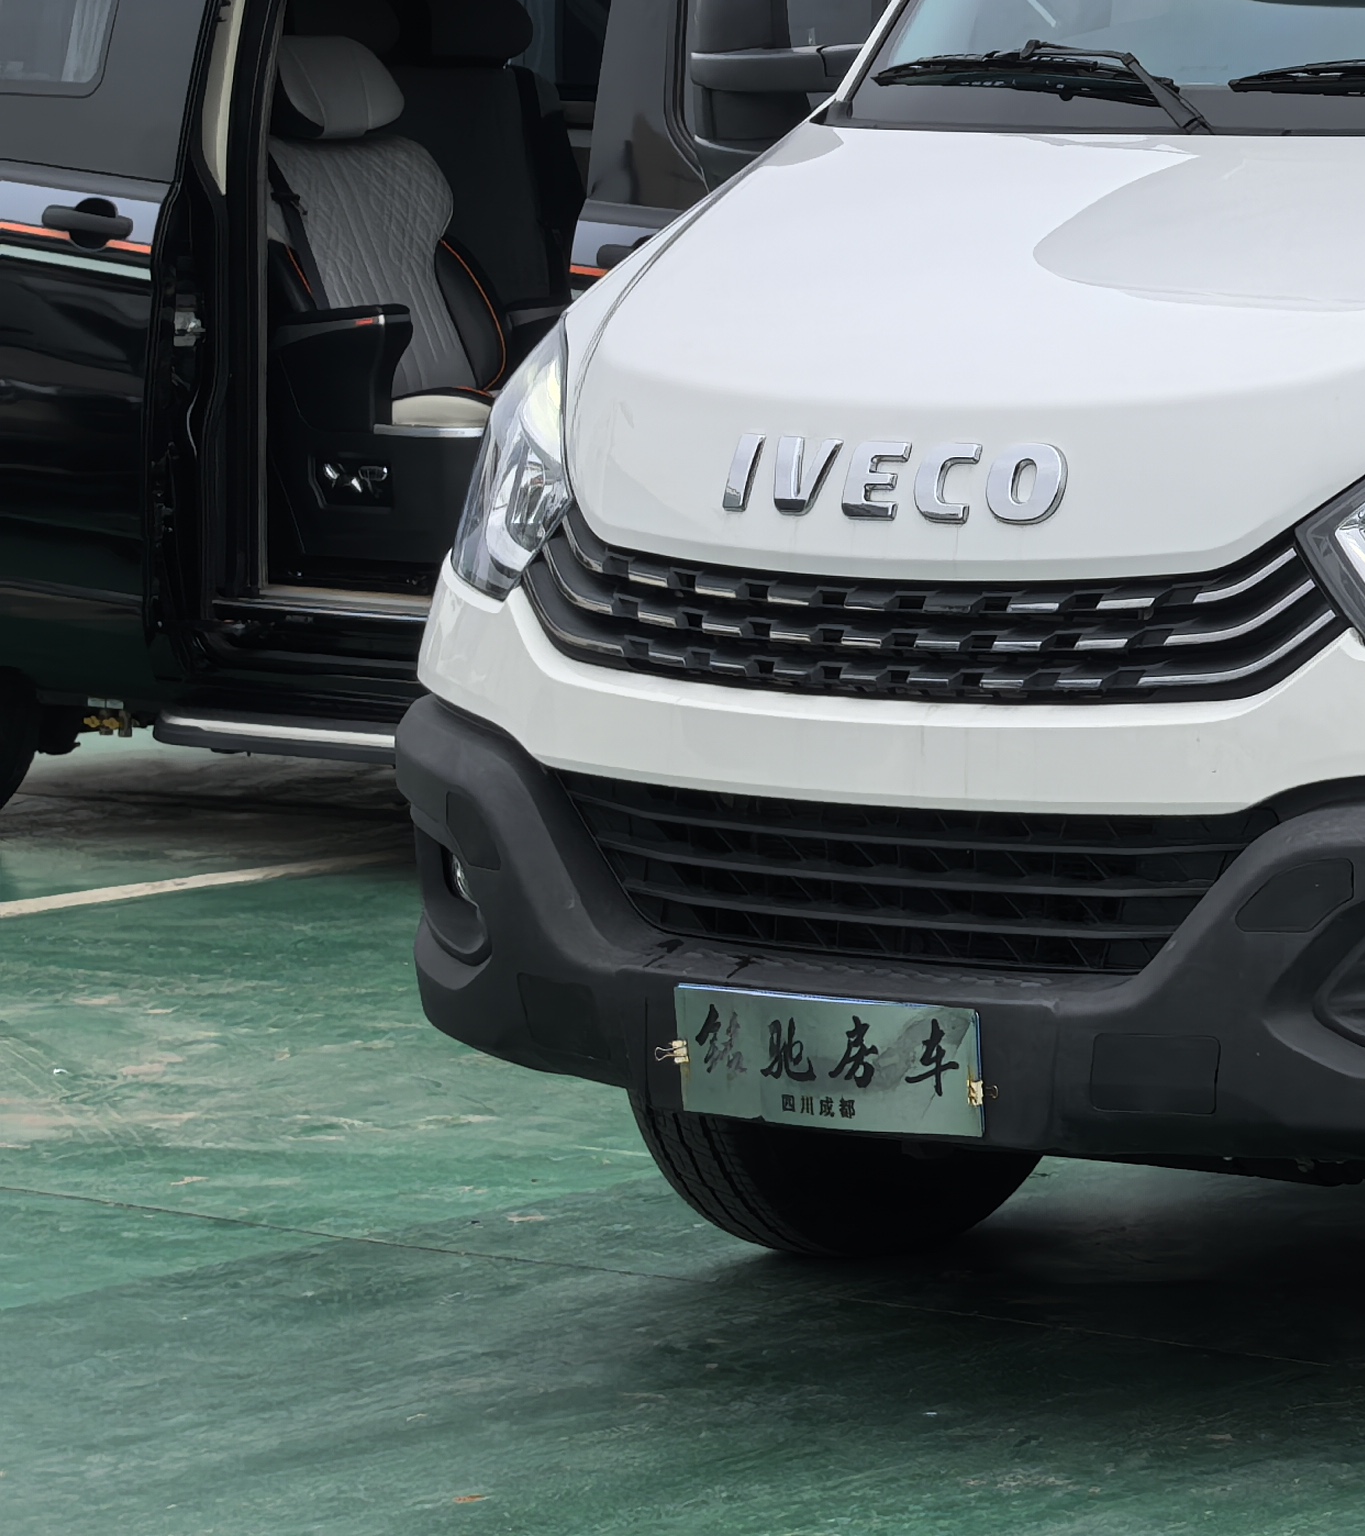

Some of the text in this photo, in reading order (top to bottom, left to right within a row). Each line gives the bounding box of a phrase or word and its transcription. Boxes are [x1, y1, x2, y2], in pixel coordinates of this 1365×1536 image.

[722, 432, 1070, 526] IVECO
[781, 1093, 857, 1120] 四川成都
